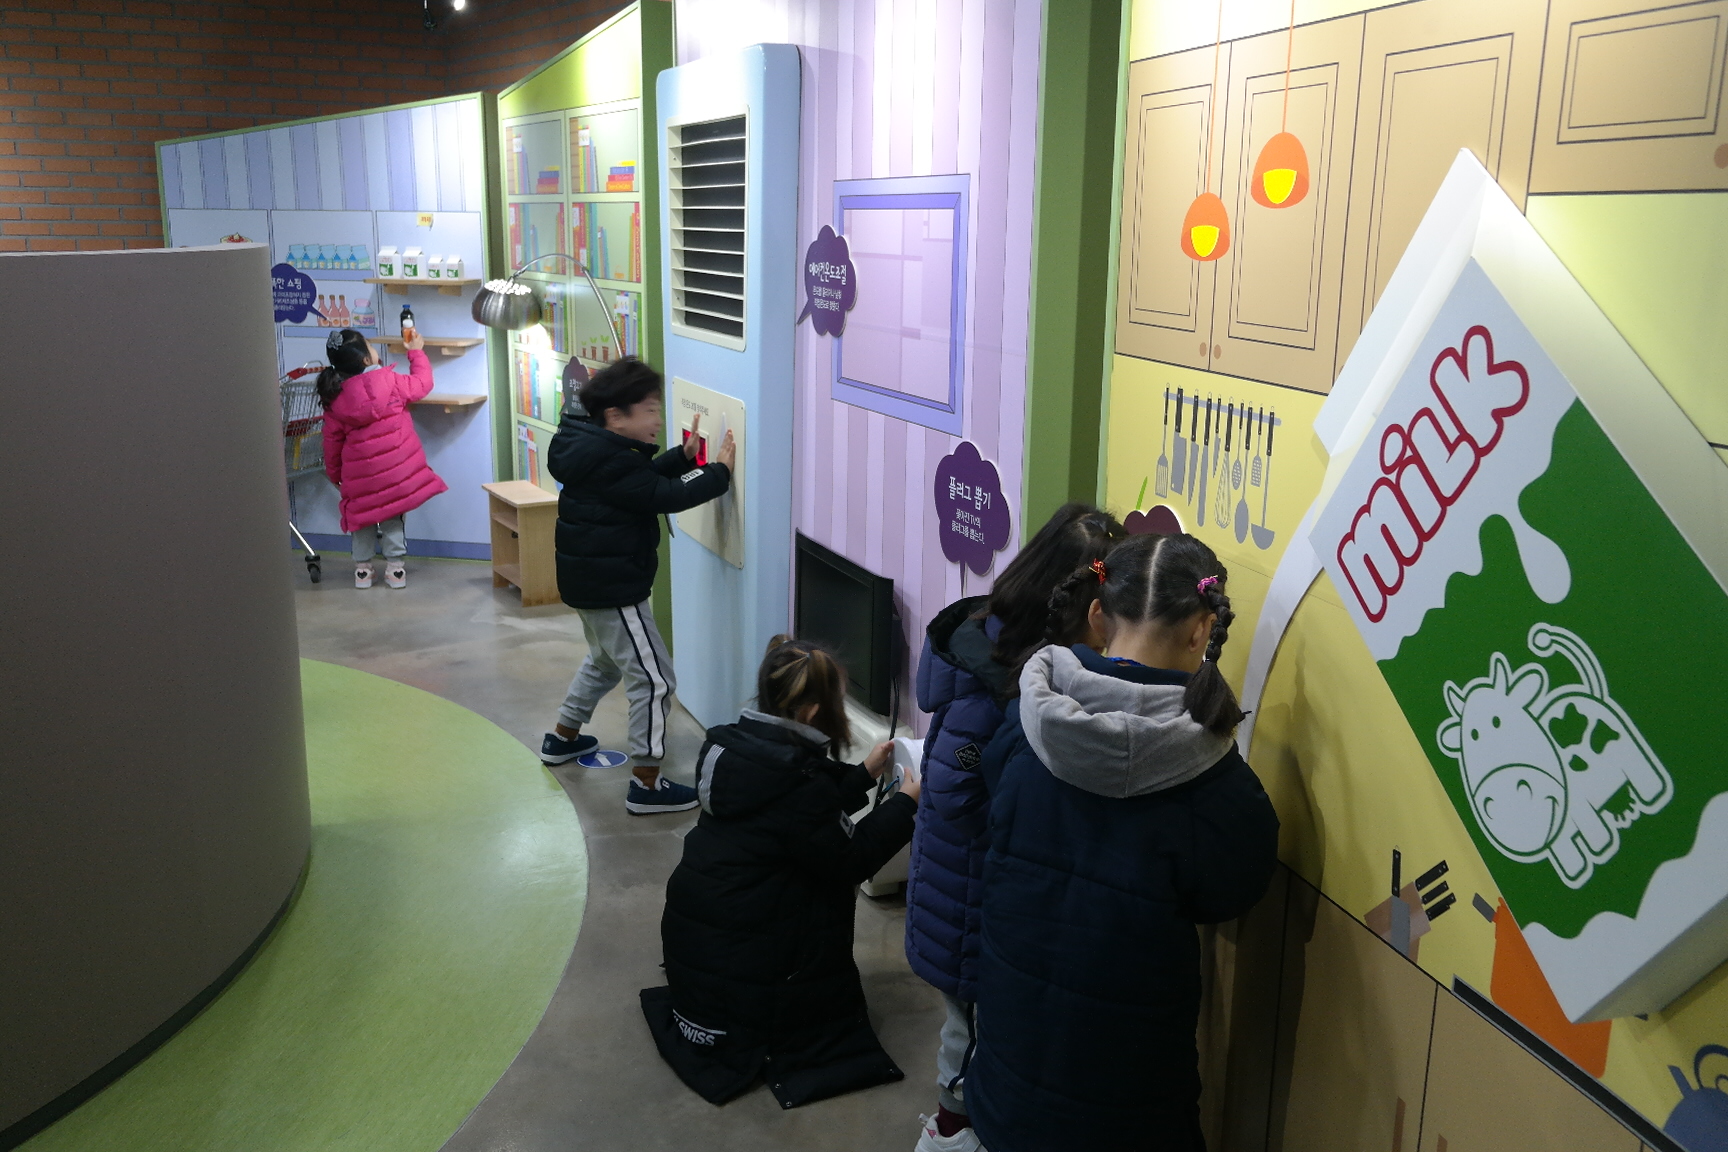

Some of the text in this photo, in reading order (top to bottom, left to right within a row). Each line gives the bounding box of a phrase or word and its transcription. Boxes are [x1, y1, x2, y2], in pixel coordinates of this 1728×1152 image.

[286, 277, 302, 291] 쇼핑
[948, 475, 992, 510] 플러그 뽑기
[678, 1021, 716, 1047] SWISS
